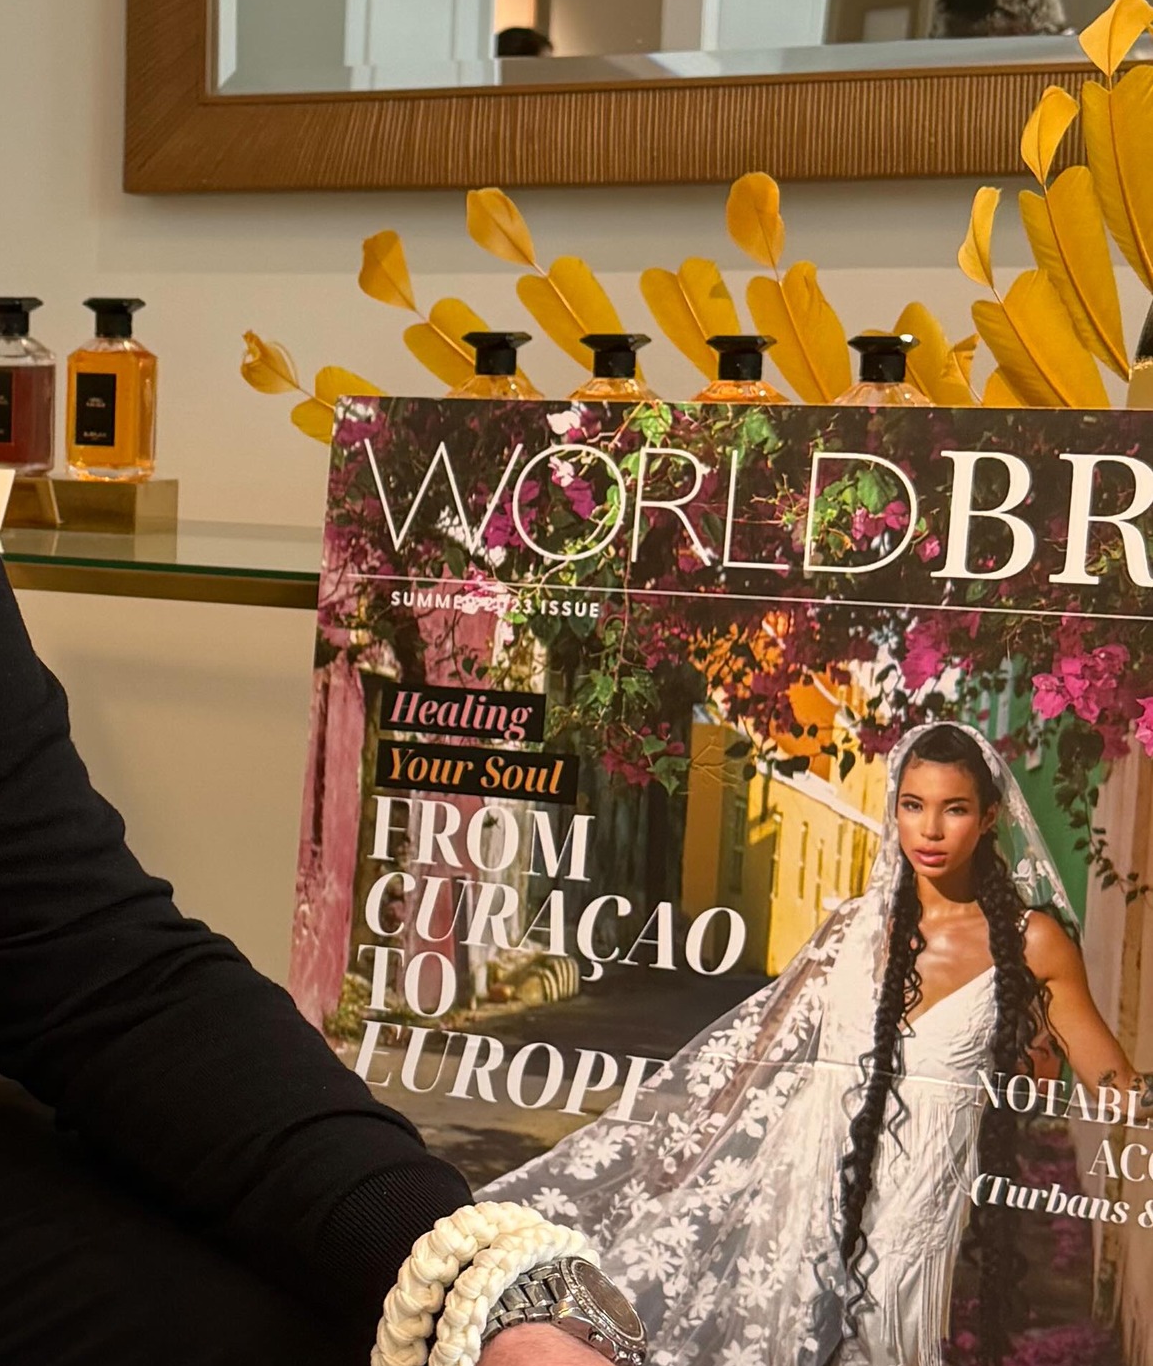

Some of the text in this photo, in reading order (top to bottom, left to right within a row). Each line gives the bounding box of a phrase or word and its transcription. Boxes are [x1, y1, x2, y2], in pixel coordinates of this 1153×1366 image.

[541, 601, 600, 617] ISSUE
[388, 691, 533, 741] Healing
[388, 747, 564, 795] Your Soul
[367, 795, 595, 882] FROM
[364, 872, 746, 982] CURAÇAO
[357, 944, 456, 1017] TO
[353, 1020, 670, 1126] EUROPE
[973, 1069, 1153, 1130] NOTABL
[1086, 1139, 1153, 1182] AC
[971, 1173, 1130, 1224] (Turbans
